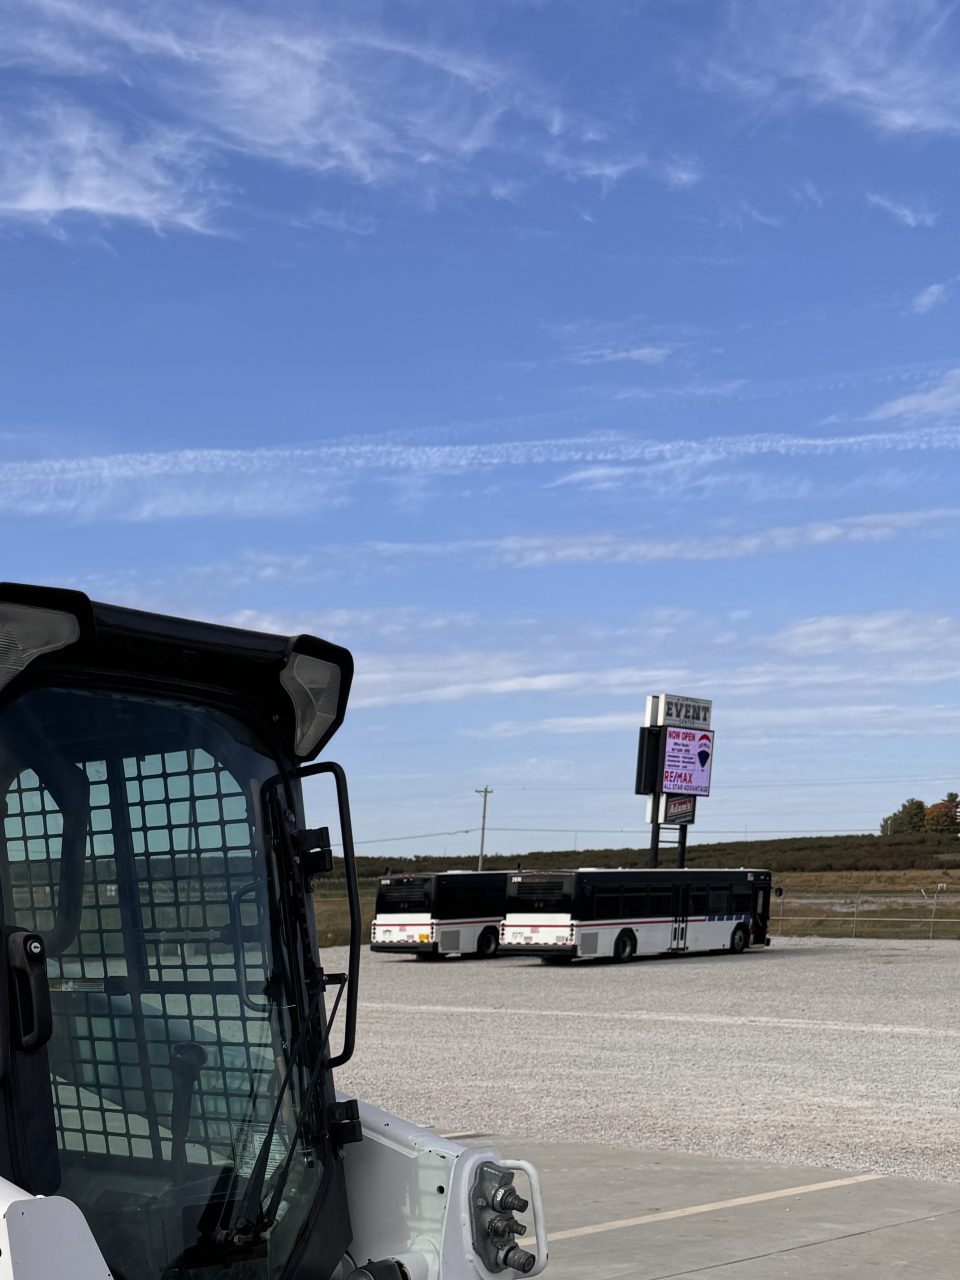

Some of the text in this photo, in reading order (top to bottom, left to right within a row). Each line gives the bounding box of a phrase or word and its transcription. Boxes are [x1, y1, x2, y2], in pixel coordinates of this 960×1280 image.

[665, 700, 710, 722] EVENT
[668, 730, 696, 741] NOW OPEN
[664, 770, 693, 785] RE/MAX
